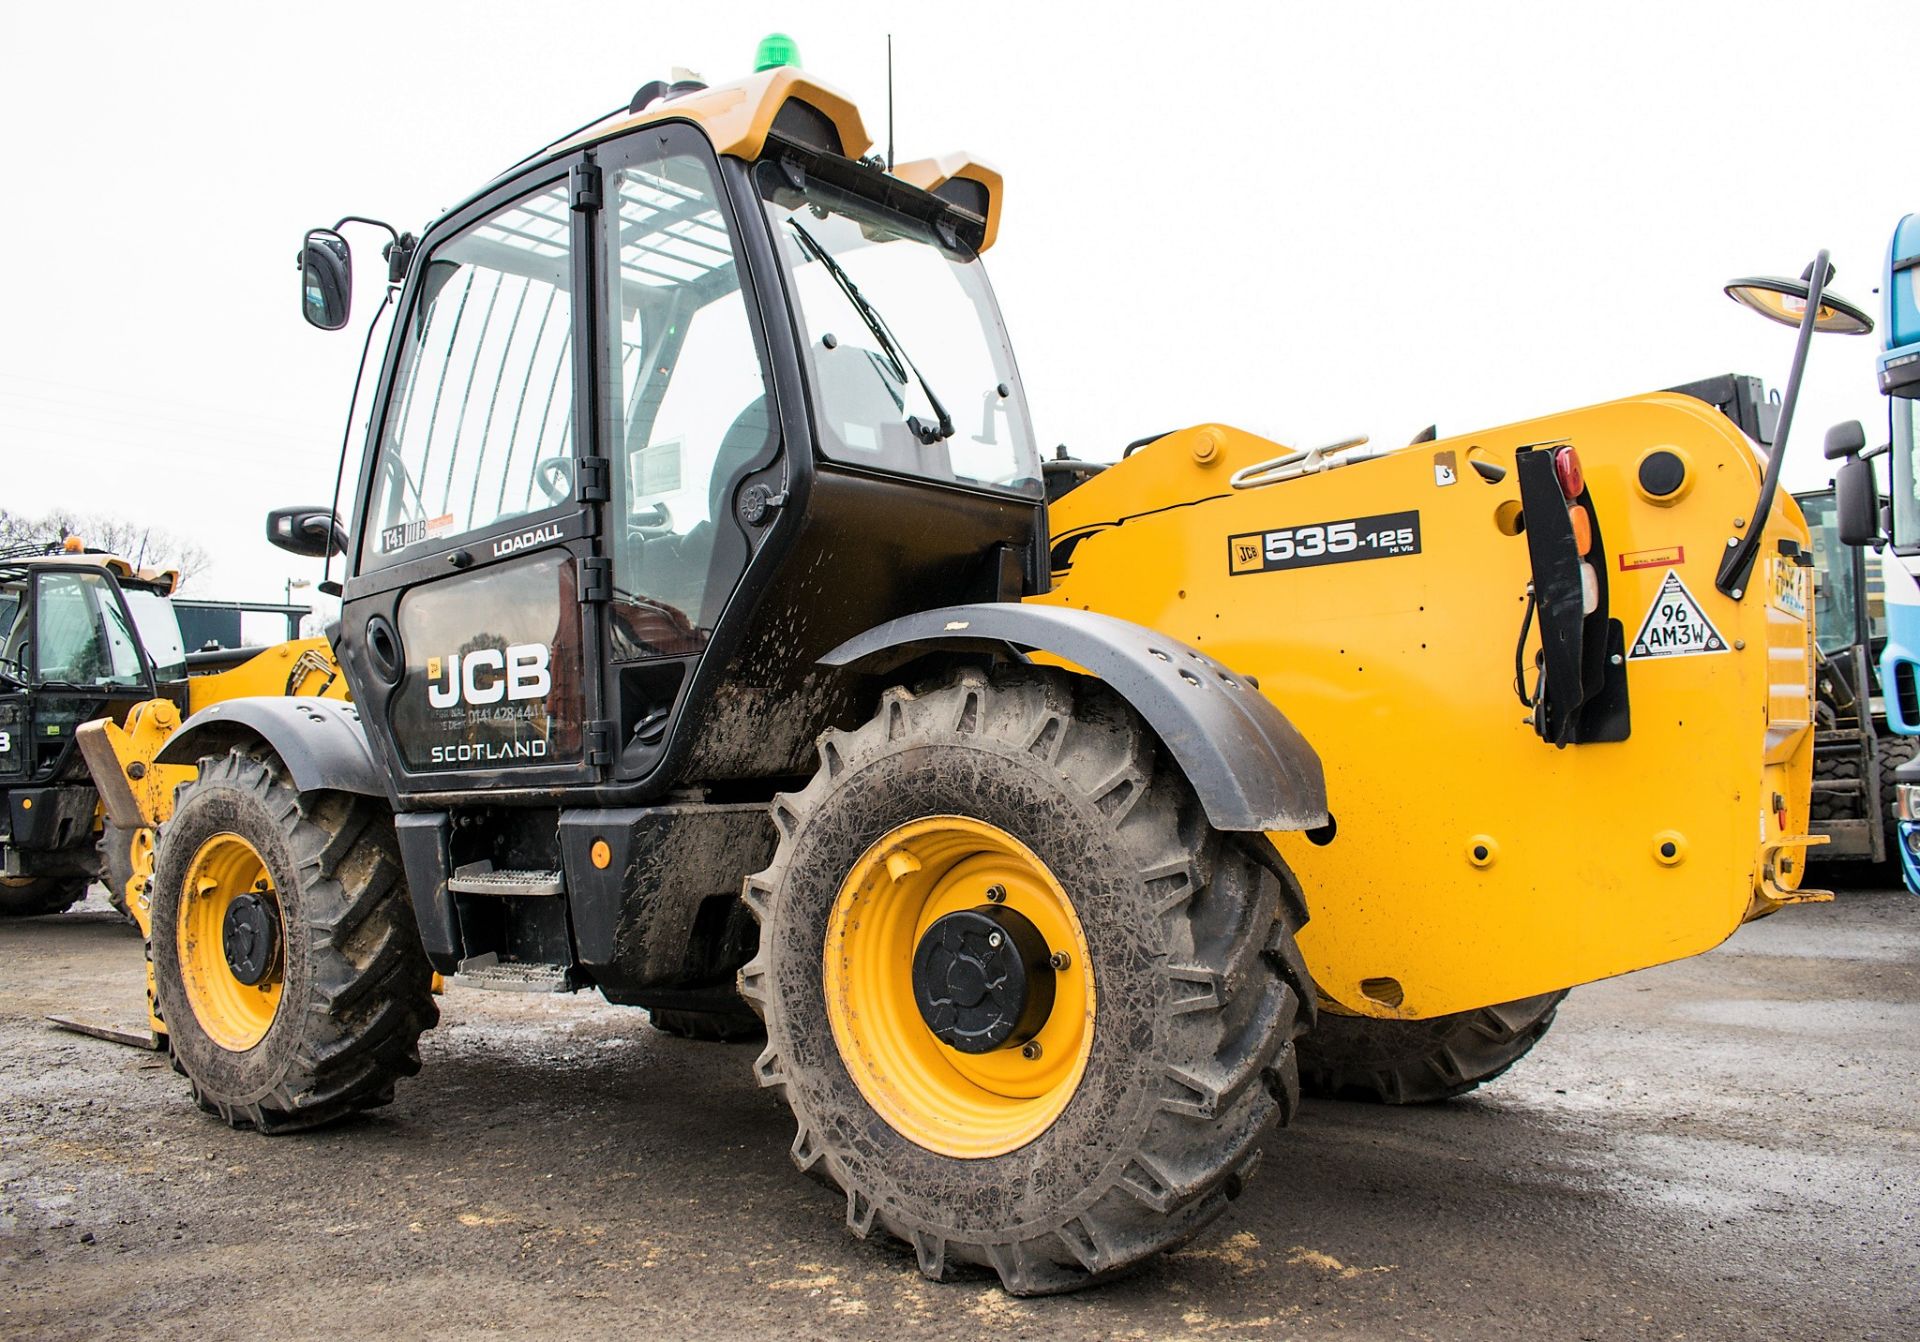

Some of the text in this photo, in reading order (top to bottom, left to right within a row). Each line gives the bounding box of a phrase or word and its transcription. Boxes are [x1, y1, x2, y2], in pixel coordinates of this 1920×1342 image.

[492, 524, 563, 557] LOADALL
[1239, 522, 1414, 563] JCB 535-125
[1389, 546, 1399, 554] Hi
[1661, 602, 1687, 624] 96
[1650, 623, 1704, 648] AM3W
[427, 643, 551, 708] JCB
[431, 739, 547, 763] SCOTLAND
